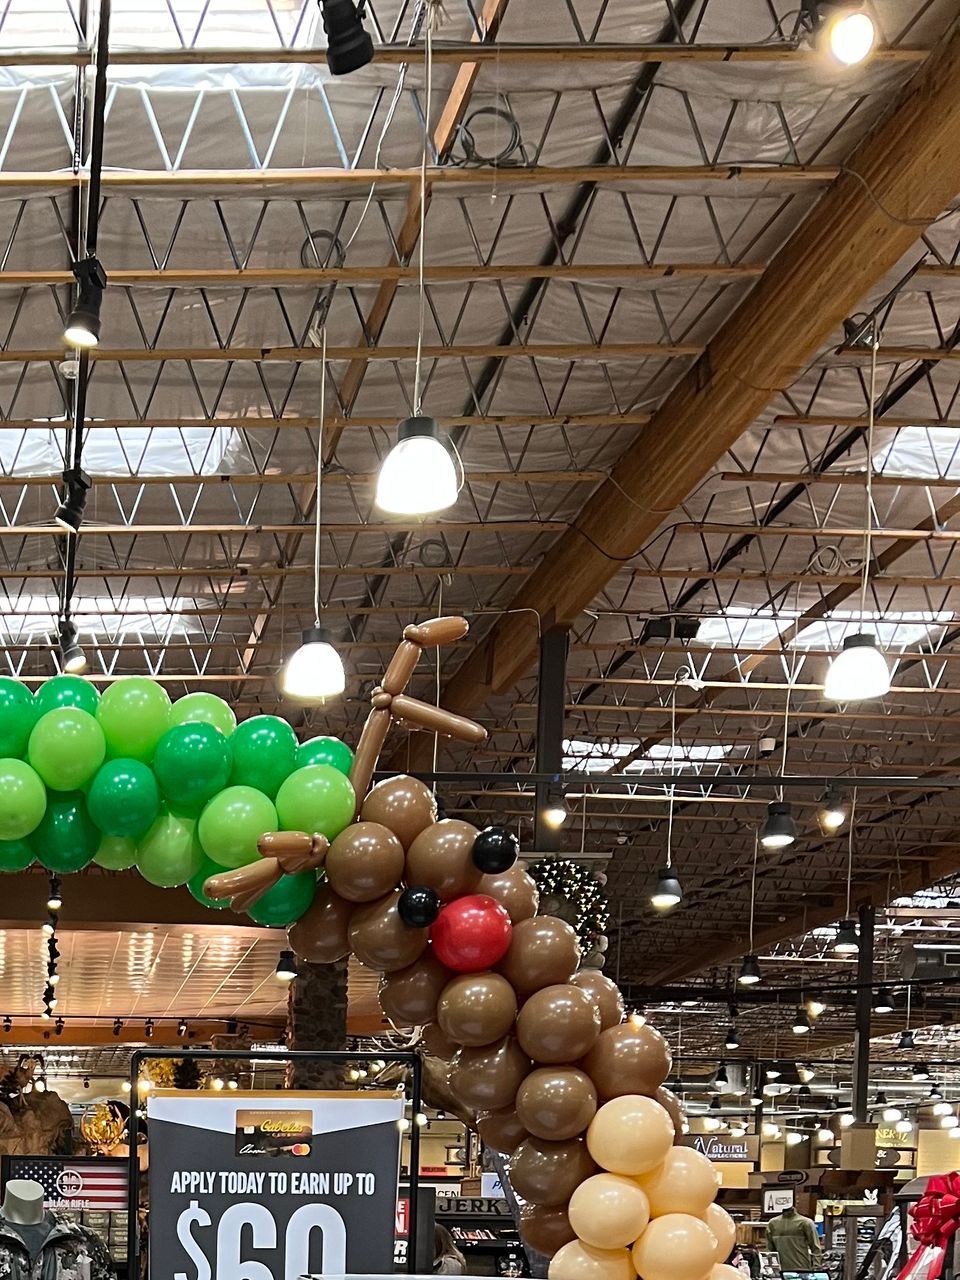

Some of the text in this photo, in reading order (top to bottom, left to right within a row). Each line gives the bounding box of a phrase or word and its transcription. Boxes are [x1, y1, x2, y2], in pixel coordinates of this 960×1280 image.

[694, 1136, 748, 1156] Natural
[171, 1171, 375, 1196] APPLY TODAY TO EARN UP TO
[439, 1198, 501, 1213] JERK
